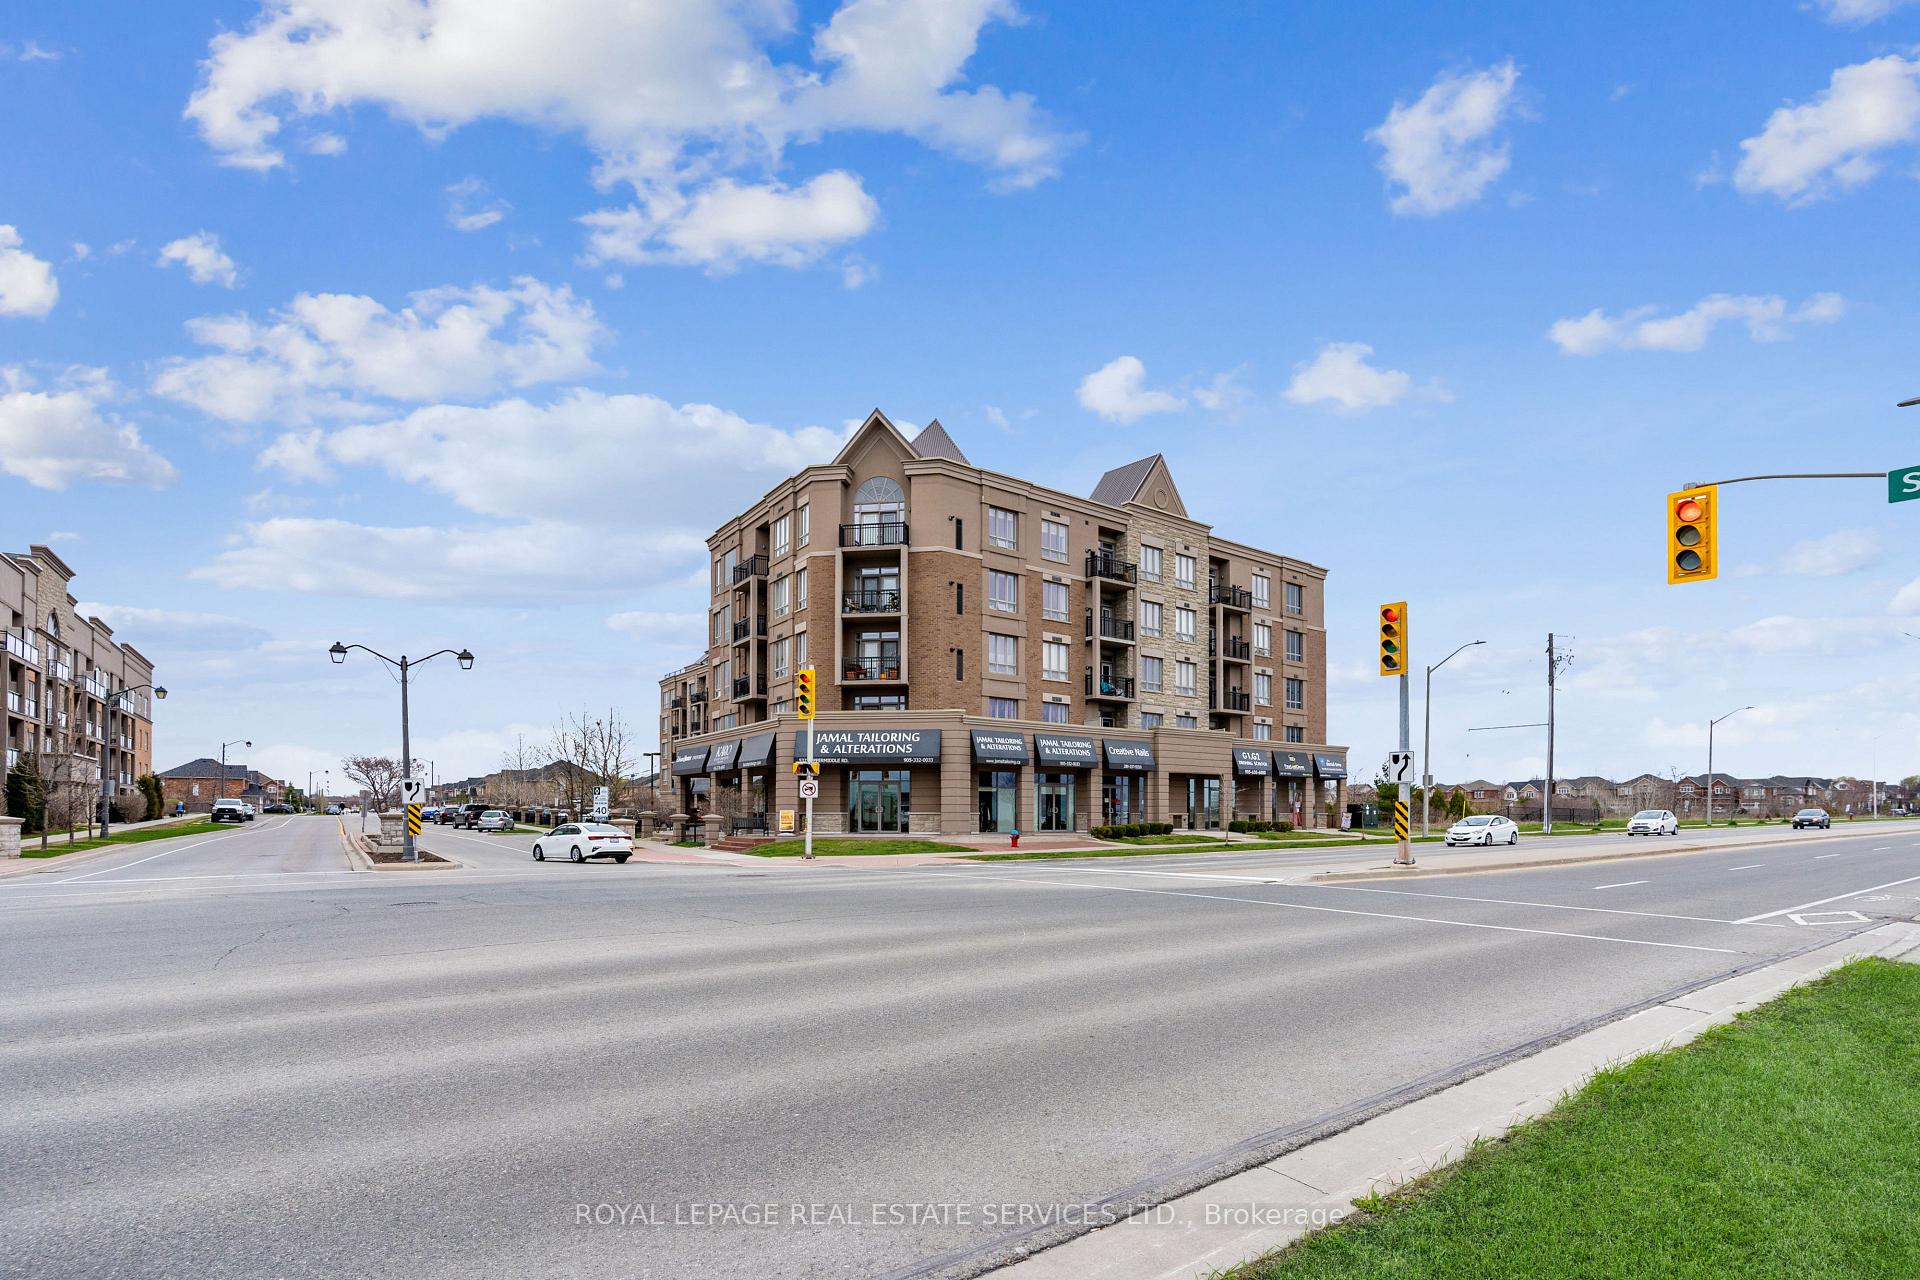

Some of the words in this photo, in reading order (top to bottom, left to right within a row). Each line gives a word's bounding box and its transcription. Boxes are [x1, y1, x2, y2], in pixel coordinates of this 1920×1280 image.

[816, 733, 853, 745] JAMAL
[857, 732, 920, 743] TAILORING
[976, 736, 993, 744] JAMAL
[994, 737, 1023, 745] TAILORING
[1040, 738, 1059, 748] JAMAL
[1060, 740, 1092, 749] TAILORING
[820, 744, 830, 754] &
[833, 743, 913, 754] ALTERATIONS
[987, 743, 1022, 752] ALTERATIONS
[1051, 747, 1091, 757] ALTERATIONS
[1108, 746, 1134, 756] Creative
[1134, 748, 1150, 757] Nails
[595, 806, 607, 815] 40
